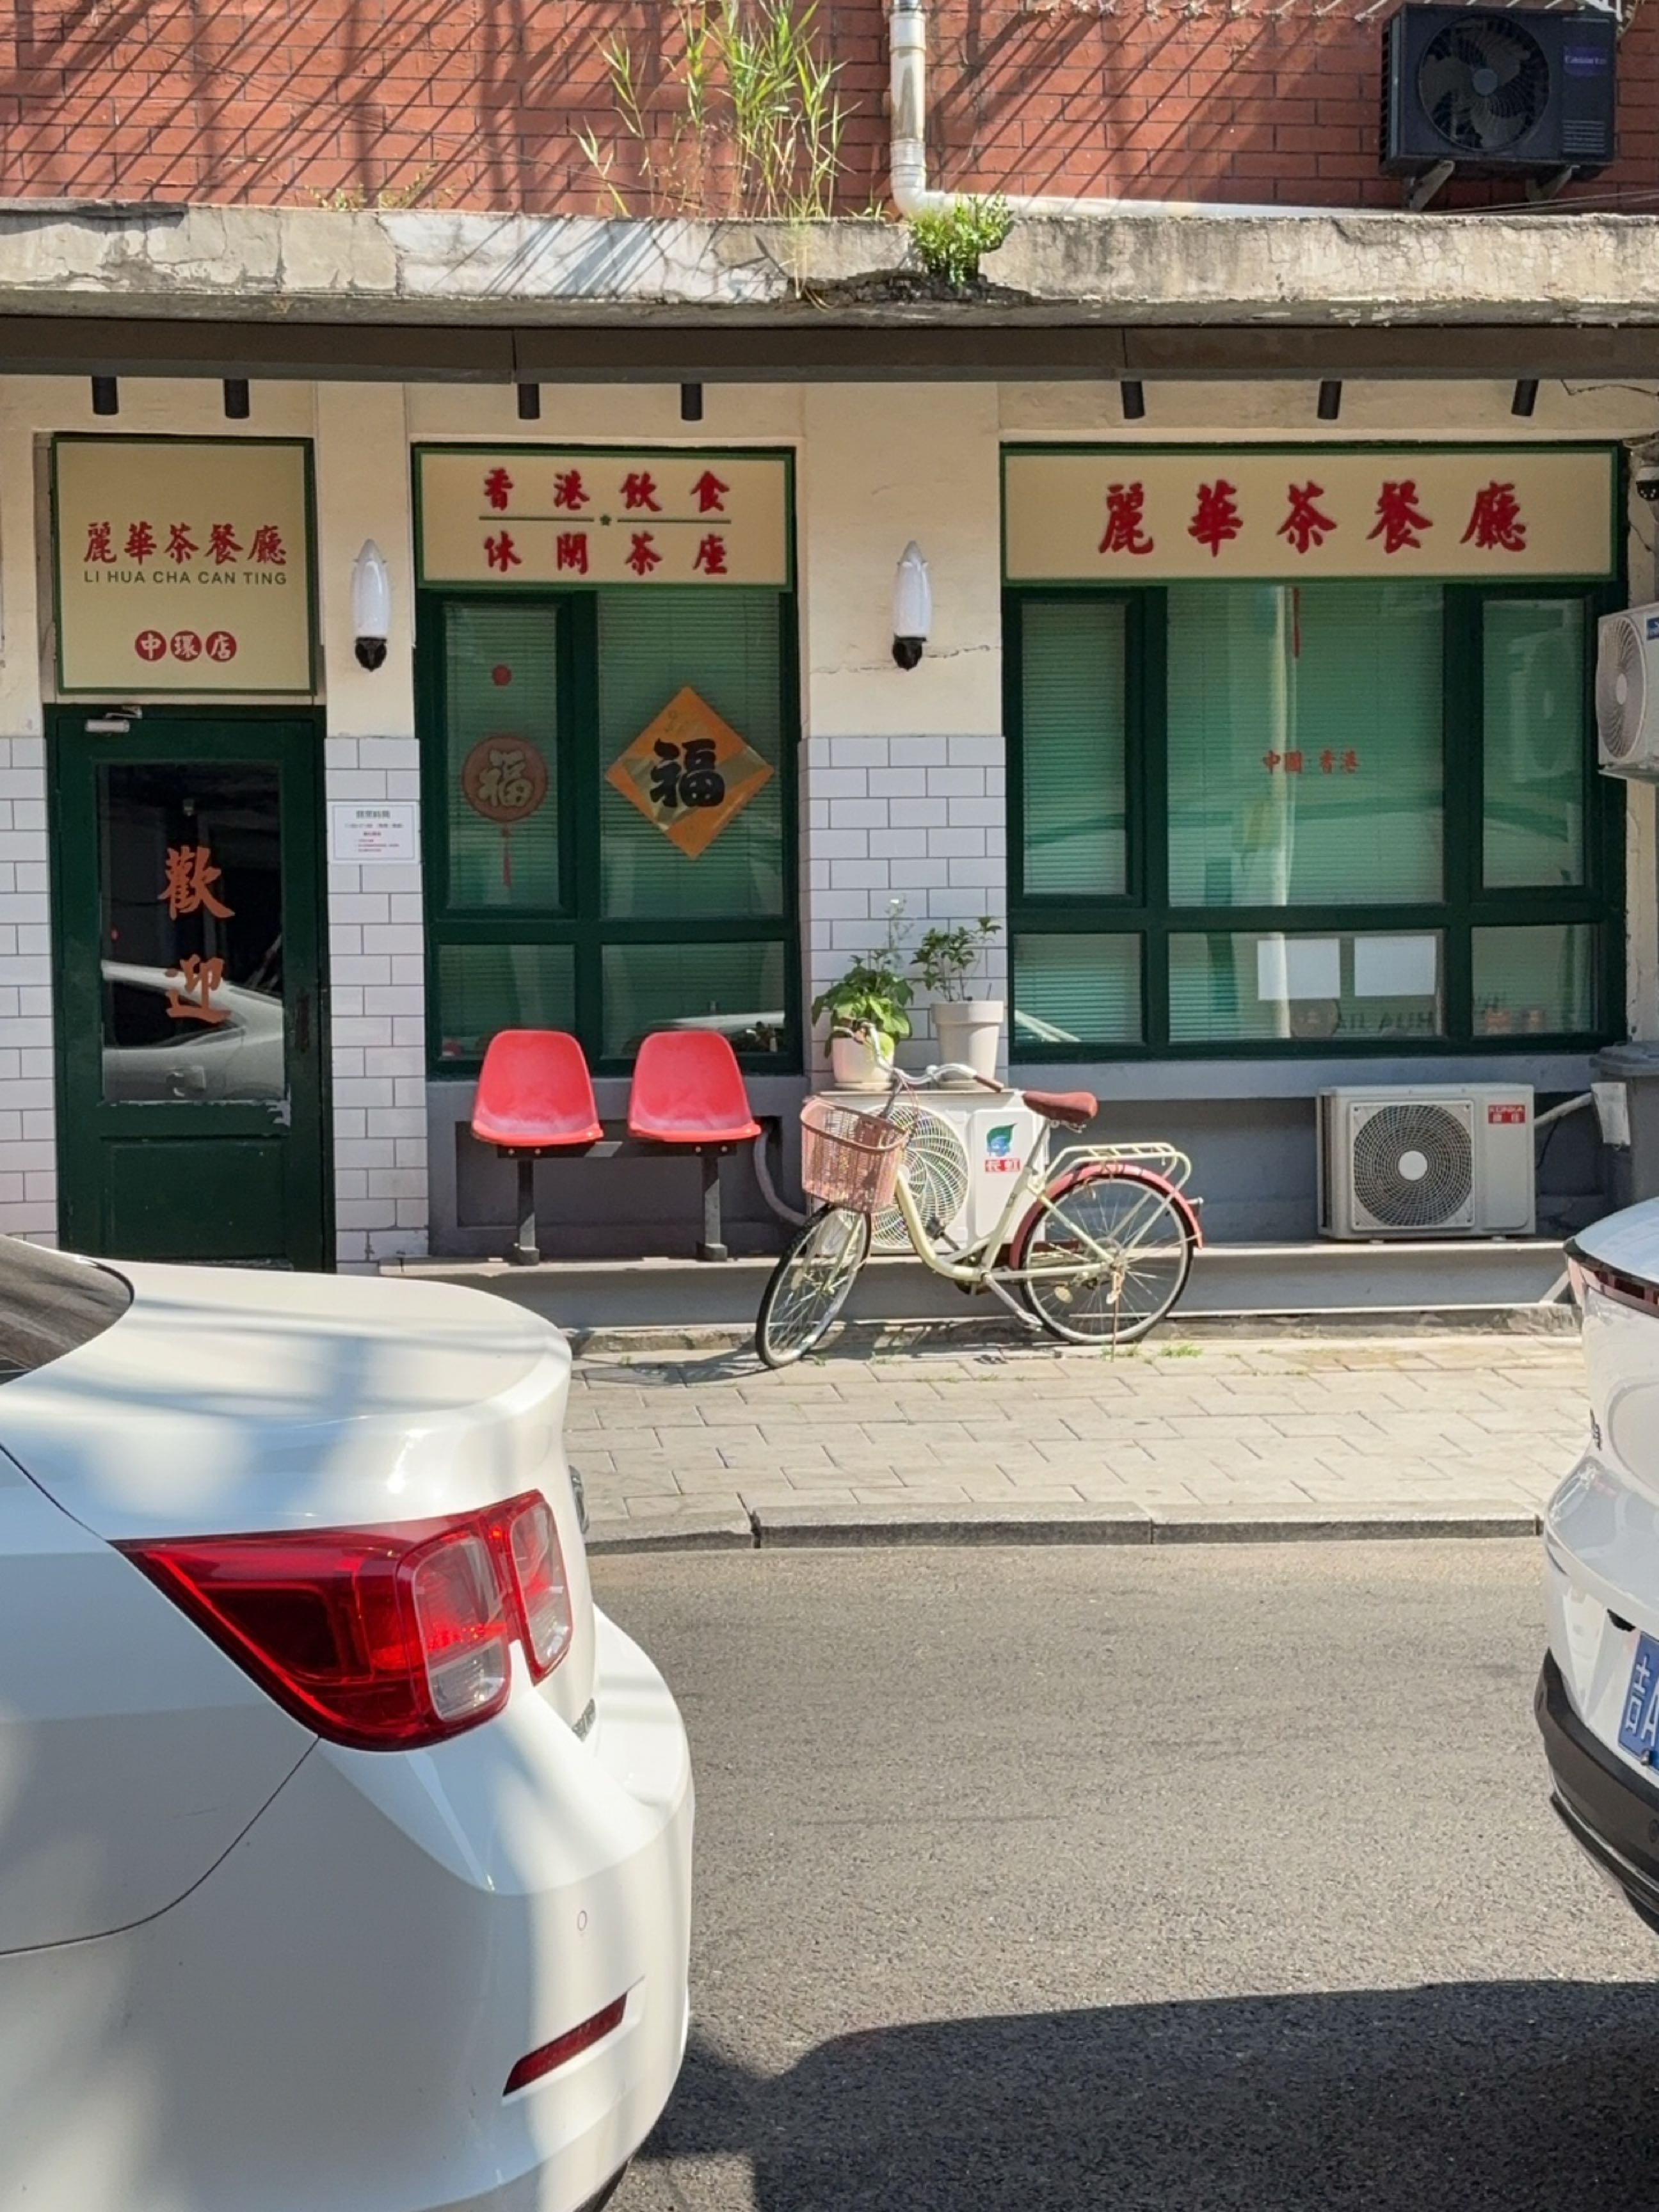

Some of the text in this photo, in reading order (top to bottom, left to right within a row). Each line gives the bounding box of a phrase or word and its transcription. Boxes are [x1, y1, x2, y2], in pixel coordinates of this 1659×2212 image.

[484, 467, 730, 513] 香港飲食
[83, 520, 287, 566] 麗華茶餐廳
[1098, 480, 1527, 557] 麗華茶餐廳
[84, 570, 287, 585] LI HUA CHA CAN TING
[134, 629, 237, 663] 中環店
[478, 748, 536, 808] 福
[649, 737, 726, 808] 福
[158, 846, 236, 1024] 歡迎
